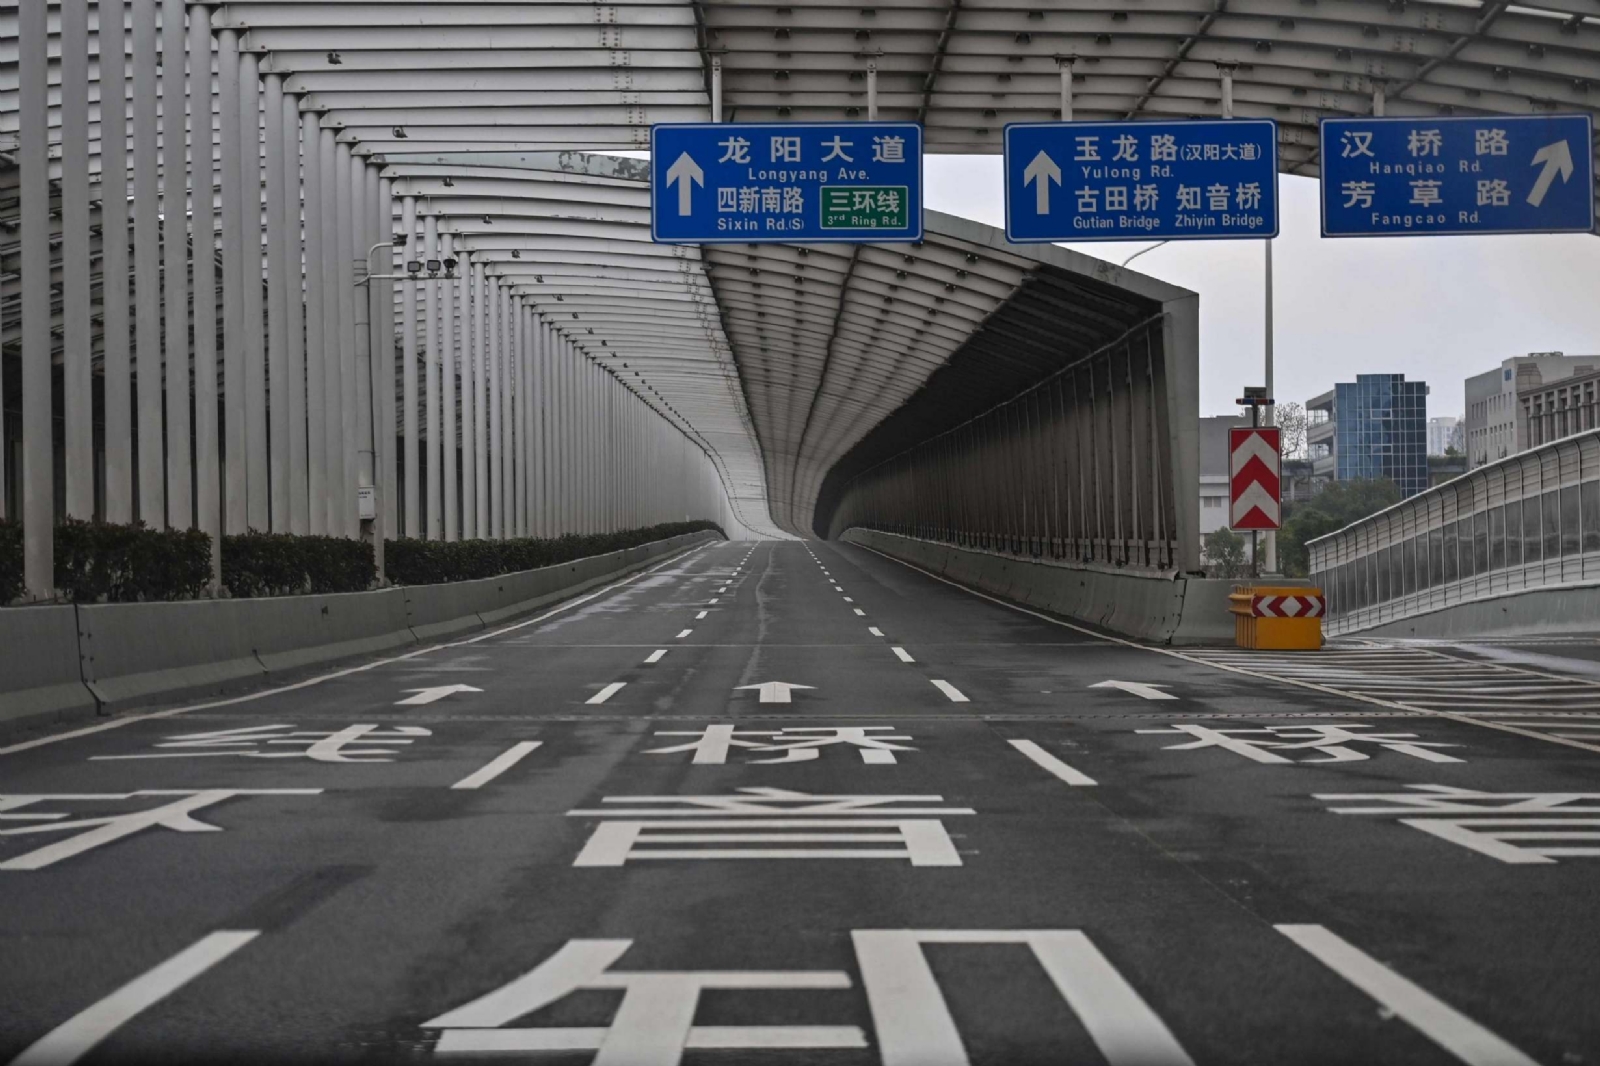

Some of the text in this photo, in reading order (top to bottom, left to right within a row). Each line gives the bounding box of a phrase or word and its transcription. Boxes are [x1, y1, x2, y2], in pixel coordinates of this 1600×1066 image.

[718, 136, 905, 163] 龙阳大道
[1340, 129, 1509, 158] 汉桥路
[749, 168, 870, 182] Longyang Ave.
[1082, 166, 1174, 180] Yulong Rd.
[1370, 160, 1482, 176] Hanqiao Rd.
[717, 187, 804, 214] 四新南路
[829, 190, 900, 213] 三环线
[1075, 182, 1262, 212] 古田桥 知音桥
[1342, 179, 1511, 208] 芳草路
[718, 219, 758, 230] Sixin
[828, 215, 901, 227] 3rd Ring Rd.
[1073, 214, 1263, 230] Gutian Bridge Zhiyin Bridge
[1372, 212, 1481, 227] Fangcao Rd.
